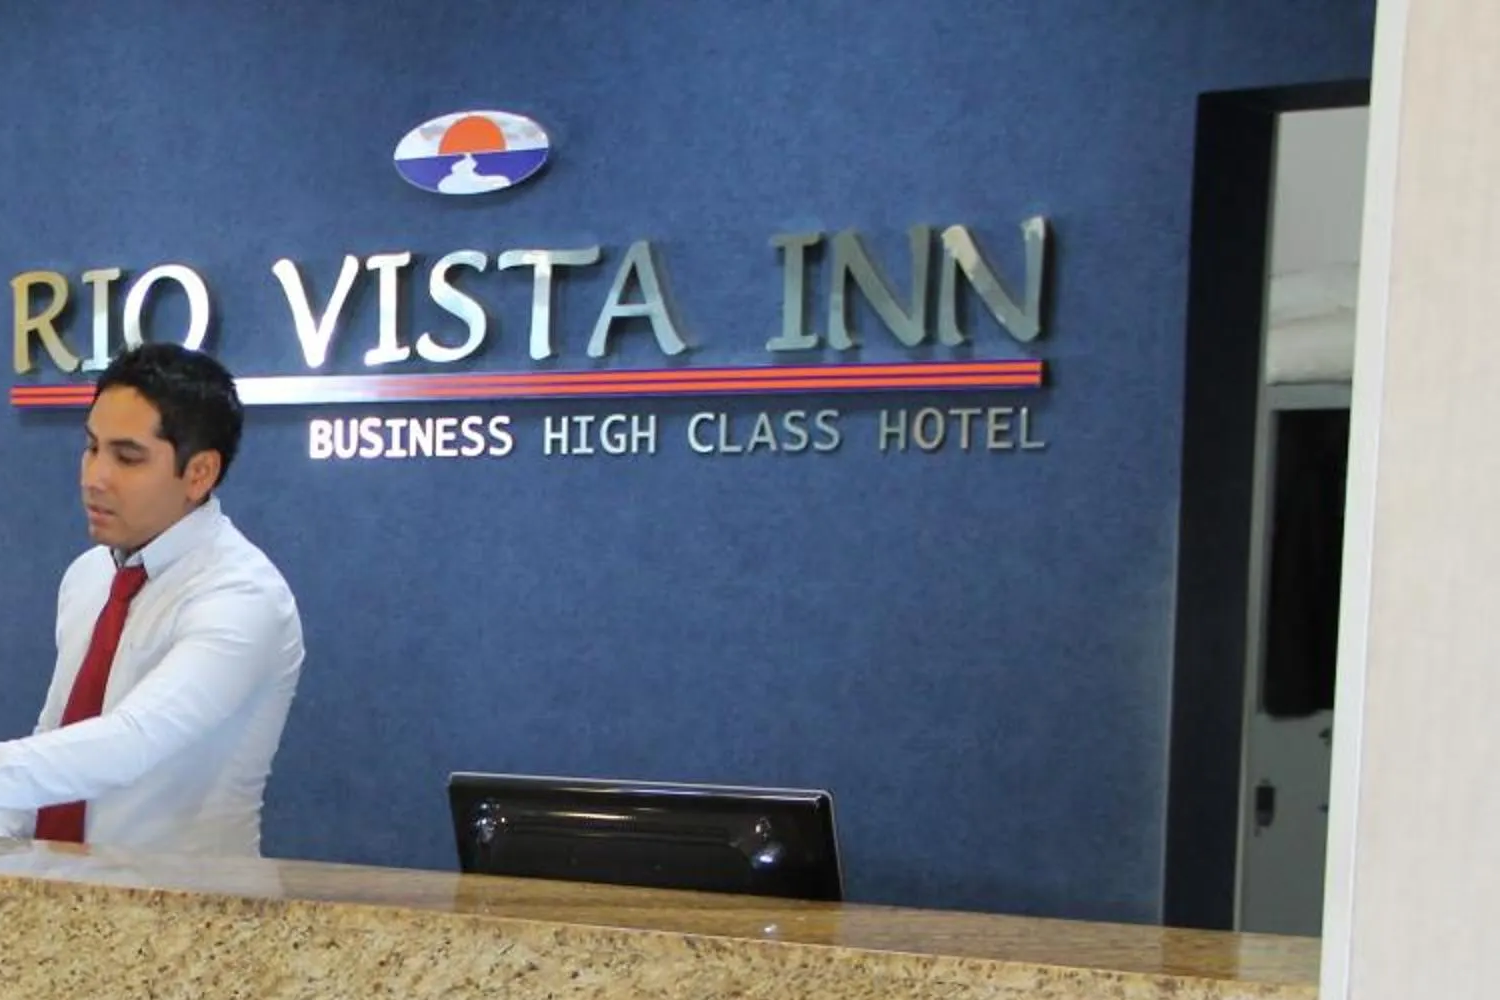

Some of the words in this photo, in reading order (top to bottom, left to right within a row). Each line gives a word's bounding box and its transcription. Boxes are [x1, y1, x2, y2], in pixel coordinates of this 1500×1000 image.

[9, 263, 210, 375] RIO
[271, 240, 688, 369] VISTA
[765, 215, 1046, 352] INN
[308, 415, 514, 460] BUSINESS
[542, 412, 657, 456] HIGH
[687, 409, 842, 454] CLASS
[878, 406, 1046, 452] HOTEL
